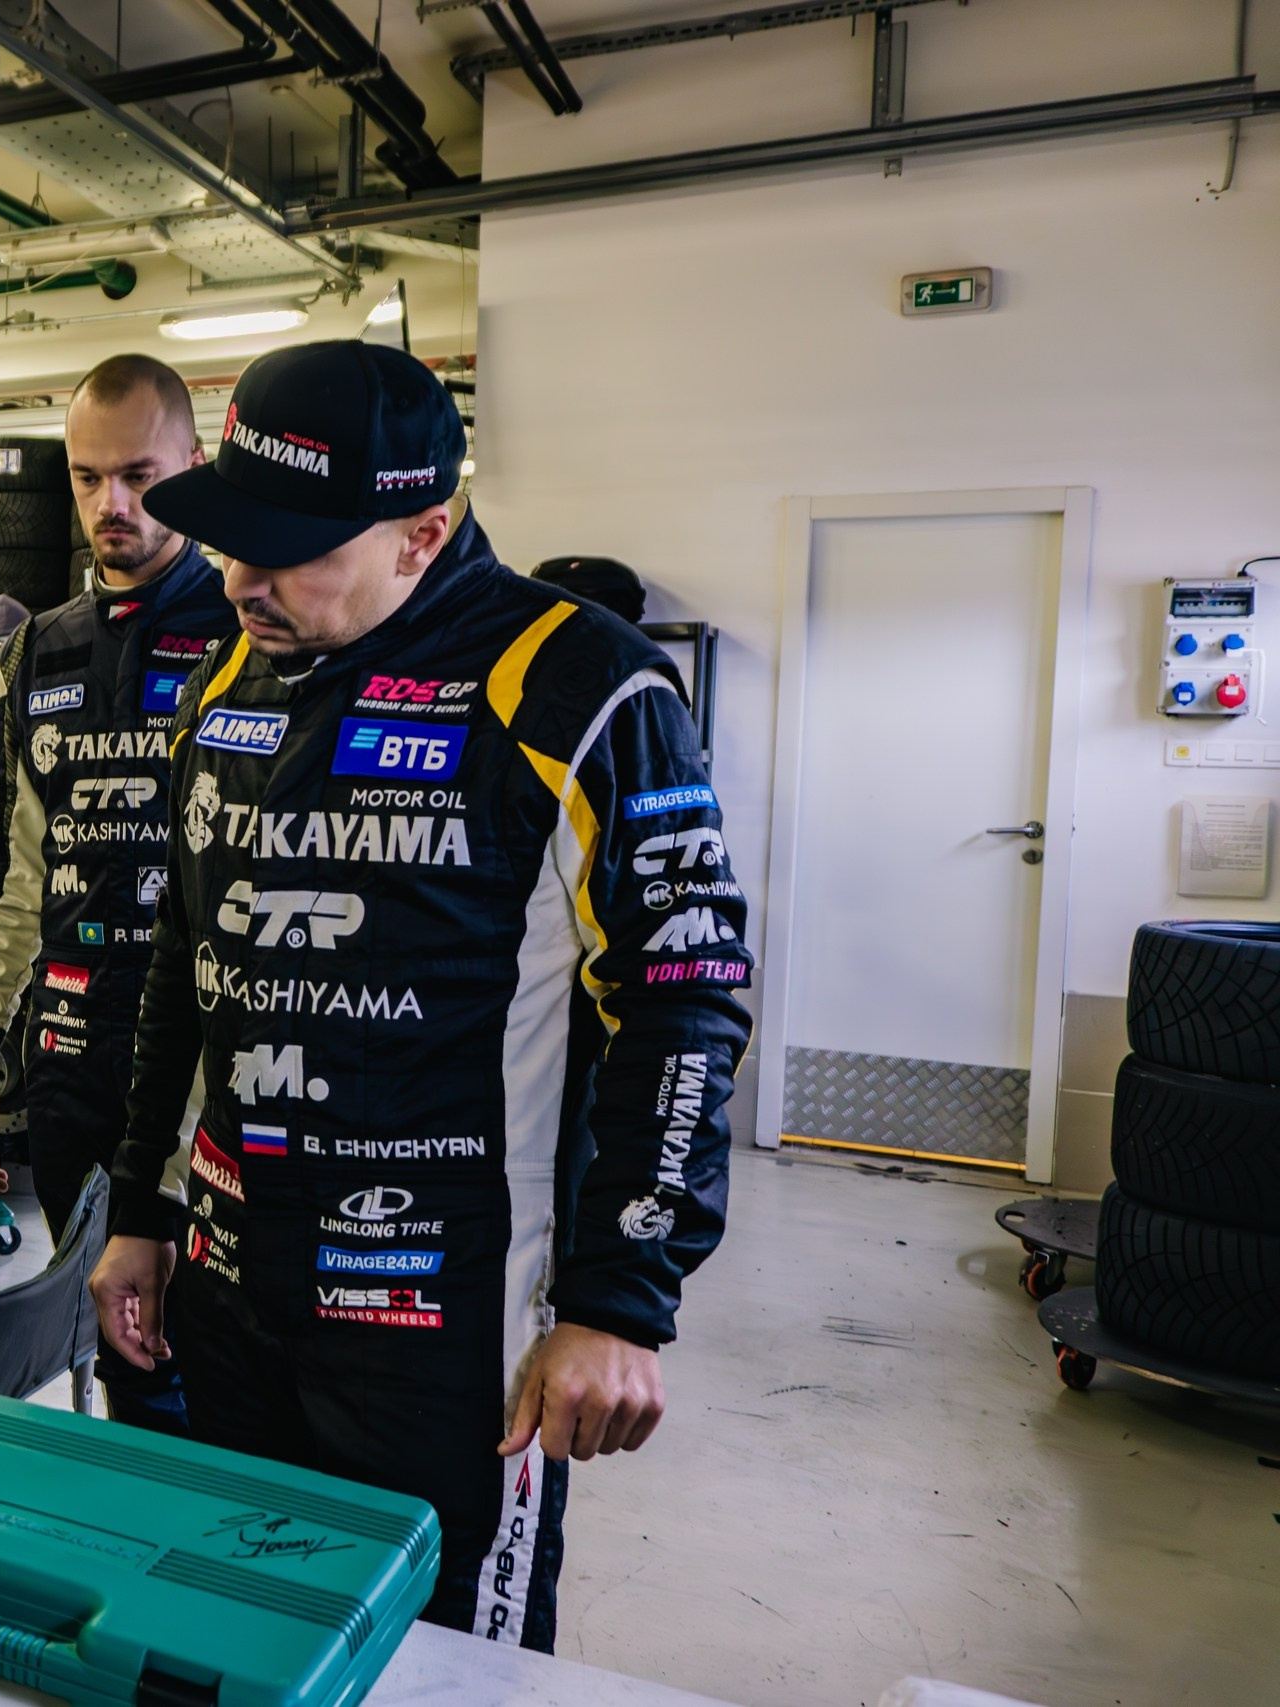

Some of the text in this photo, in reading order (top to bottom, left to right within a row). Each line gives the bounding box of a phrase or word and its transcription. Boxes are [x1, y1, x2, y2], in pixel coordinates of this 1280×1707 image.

[232, 423, 329, 477] TAKAYAMA
[284, 432, 330, 452] MOTOR OIL
[376, 466, 436, 482] FORWARD
[438, 681, 478, 699] GP
[355, 698, 470, 714] RUSSIAN DRIFT SERIES
[147, 717, 174, 728] MOT
[201, 715, 278, 748] AIMOL
[65, 732, 169, 761] TAKAYA
[378, 735, 450, 771] ВТБ
[350, 788, 466, 810] MOTOR OIL
[631, 789, 714, 813] VIRAGE24.RU
[77, 822, 169, 843] KASHIYAM
[224, 802, 472, 866] TAKAYAMA
[674, 880, 741, 897] KASHIYAMA
[222, 965, 424, 1020] KASHIYAMA
[655, 1054, 677, 1117] MOTOR OIL
[654, 1053, 707, 1196] TAKAYAMA
[335, 1136, 486, 1160] CHIVCHYAN
[320, 1216, 444, 1238] LINGLONG TIRE
[325, 1252, 434, 1271] VIRAGE24.RU
[320, 1309, 437, 1327] FORGED WHEELS
